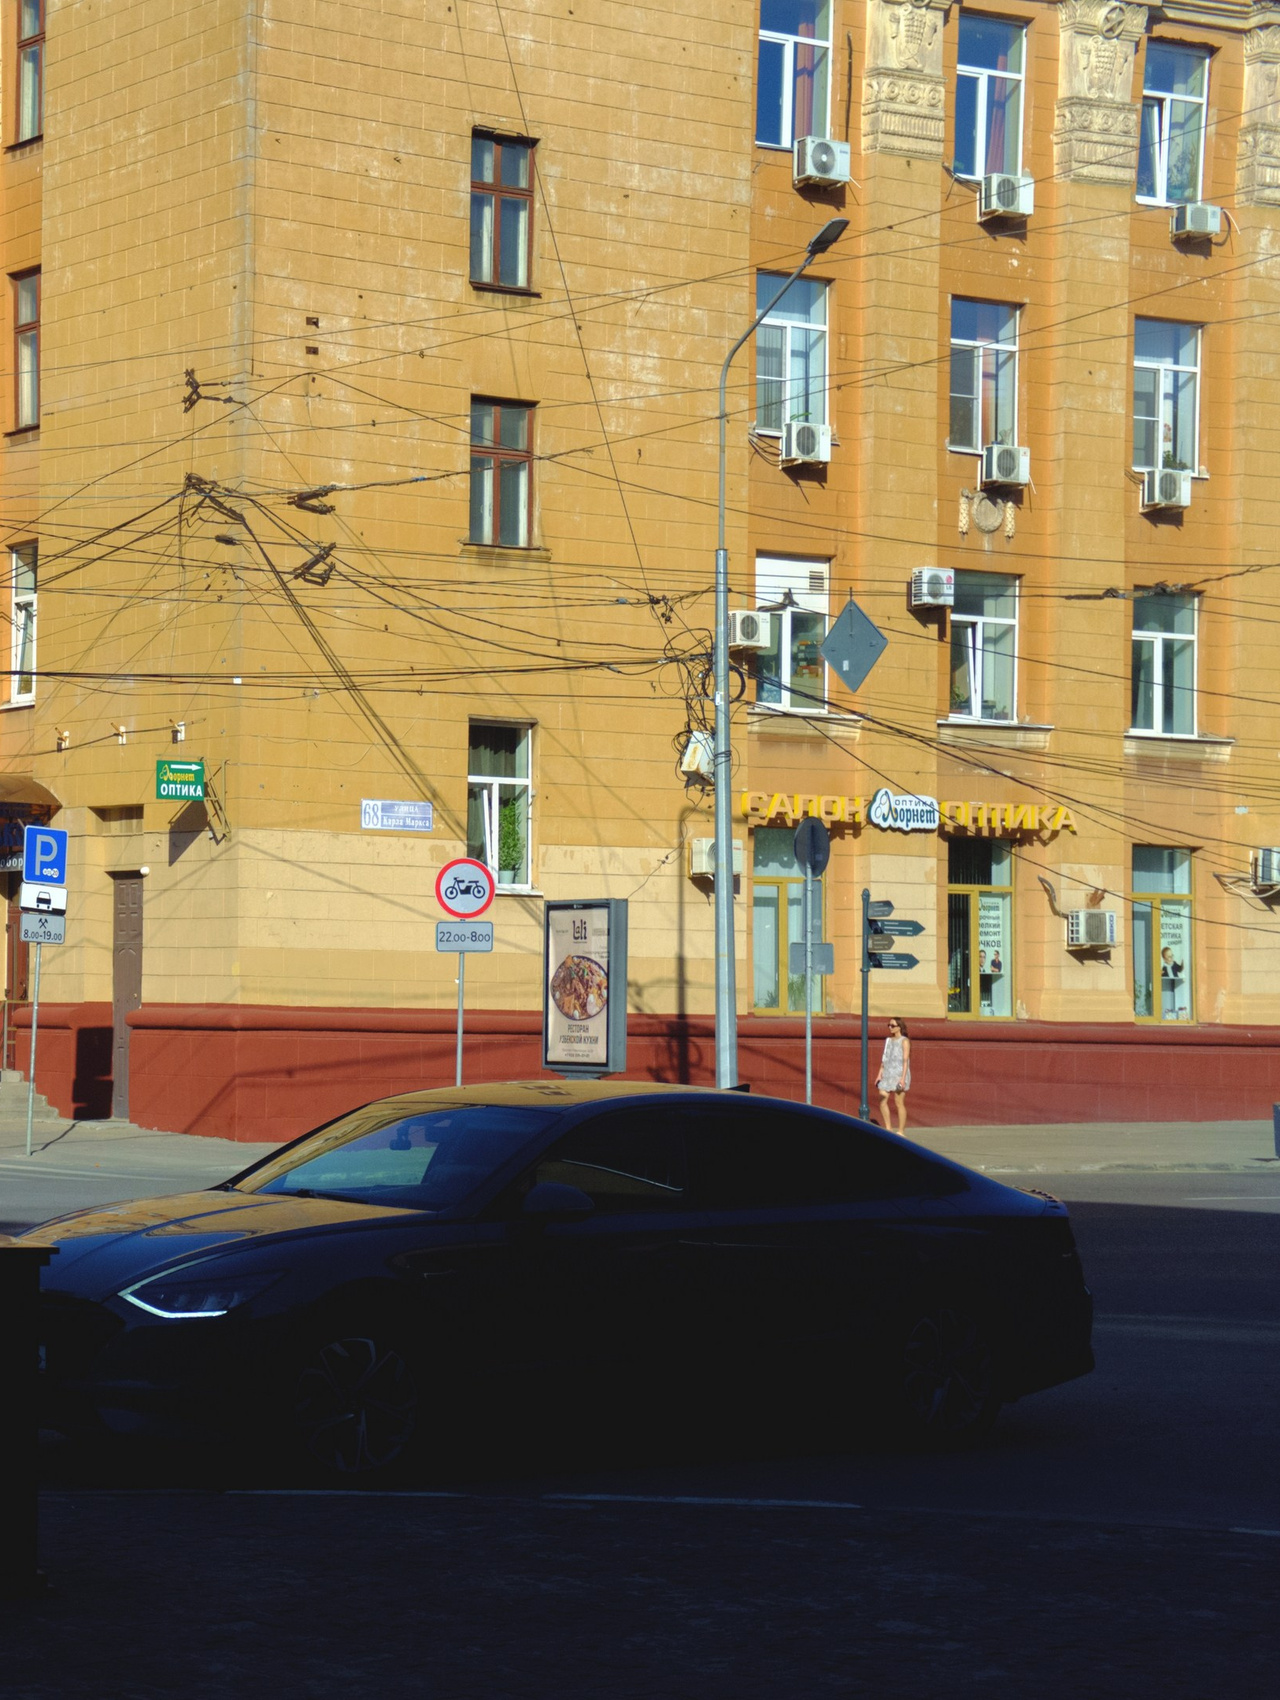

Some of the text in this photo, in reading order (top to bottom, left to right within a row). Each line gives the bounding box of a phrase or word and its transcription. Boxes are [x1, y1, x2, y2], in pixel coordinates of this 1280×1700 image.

[160, 783, 203, 797] ОПТИКА
[363, 803, 379, 826] 68
[741, 791, 865, 822] САЛОН
[882, 790, 936, 829] Лорнет
[939, 800, 1078, 831] ОПТИКА
[23, 929, 62, 941] 8.00-19.00
[979, 922, 1001, 930] елкий
[1160, 922, 1183, 930] ЕТСКАЯ
